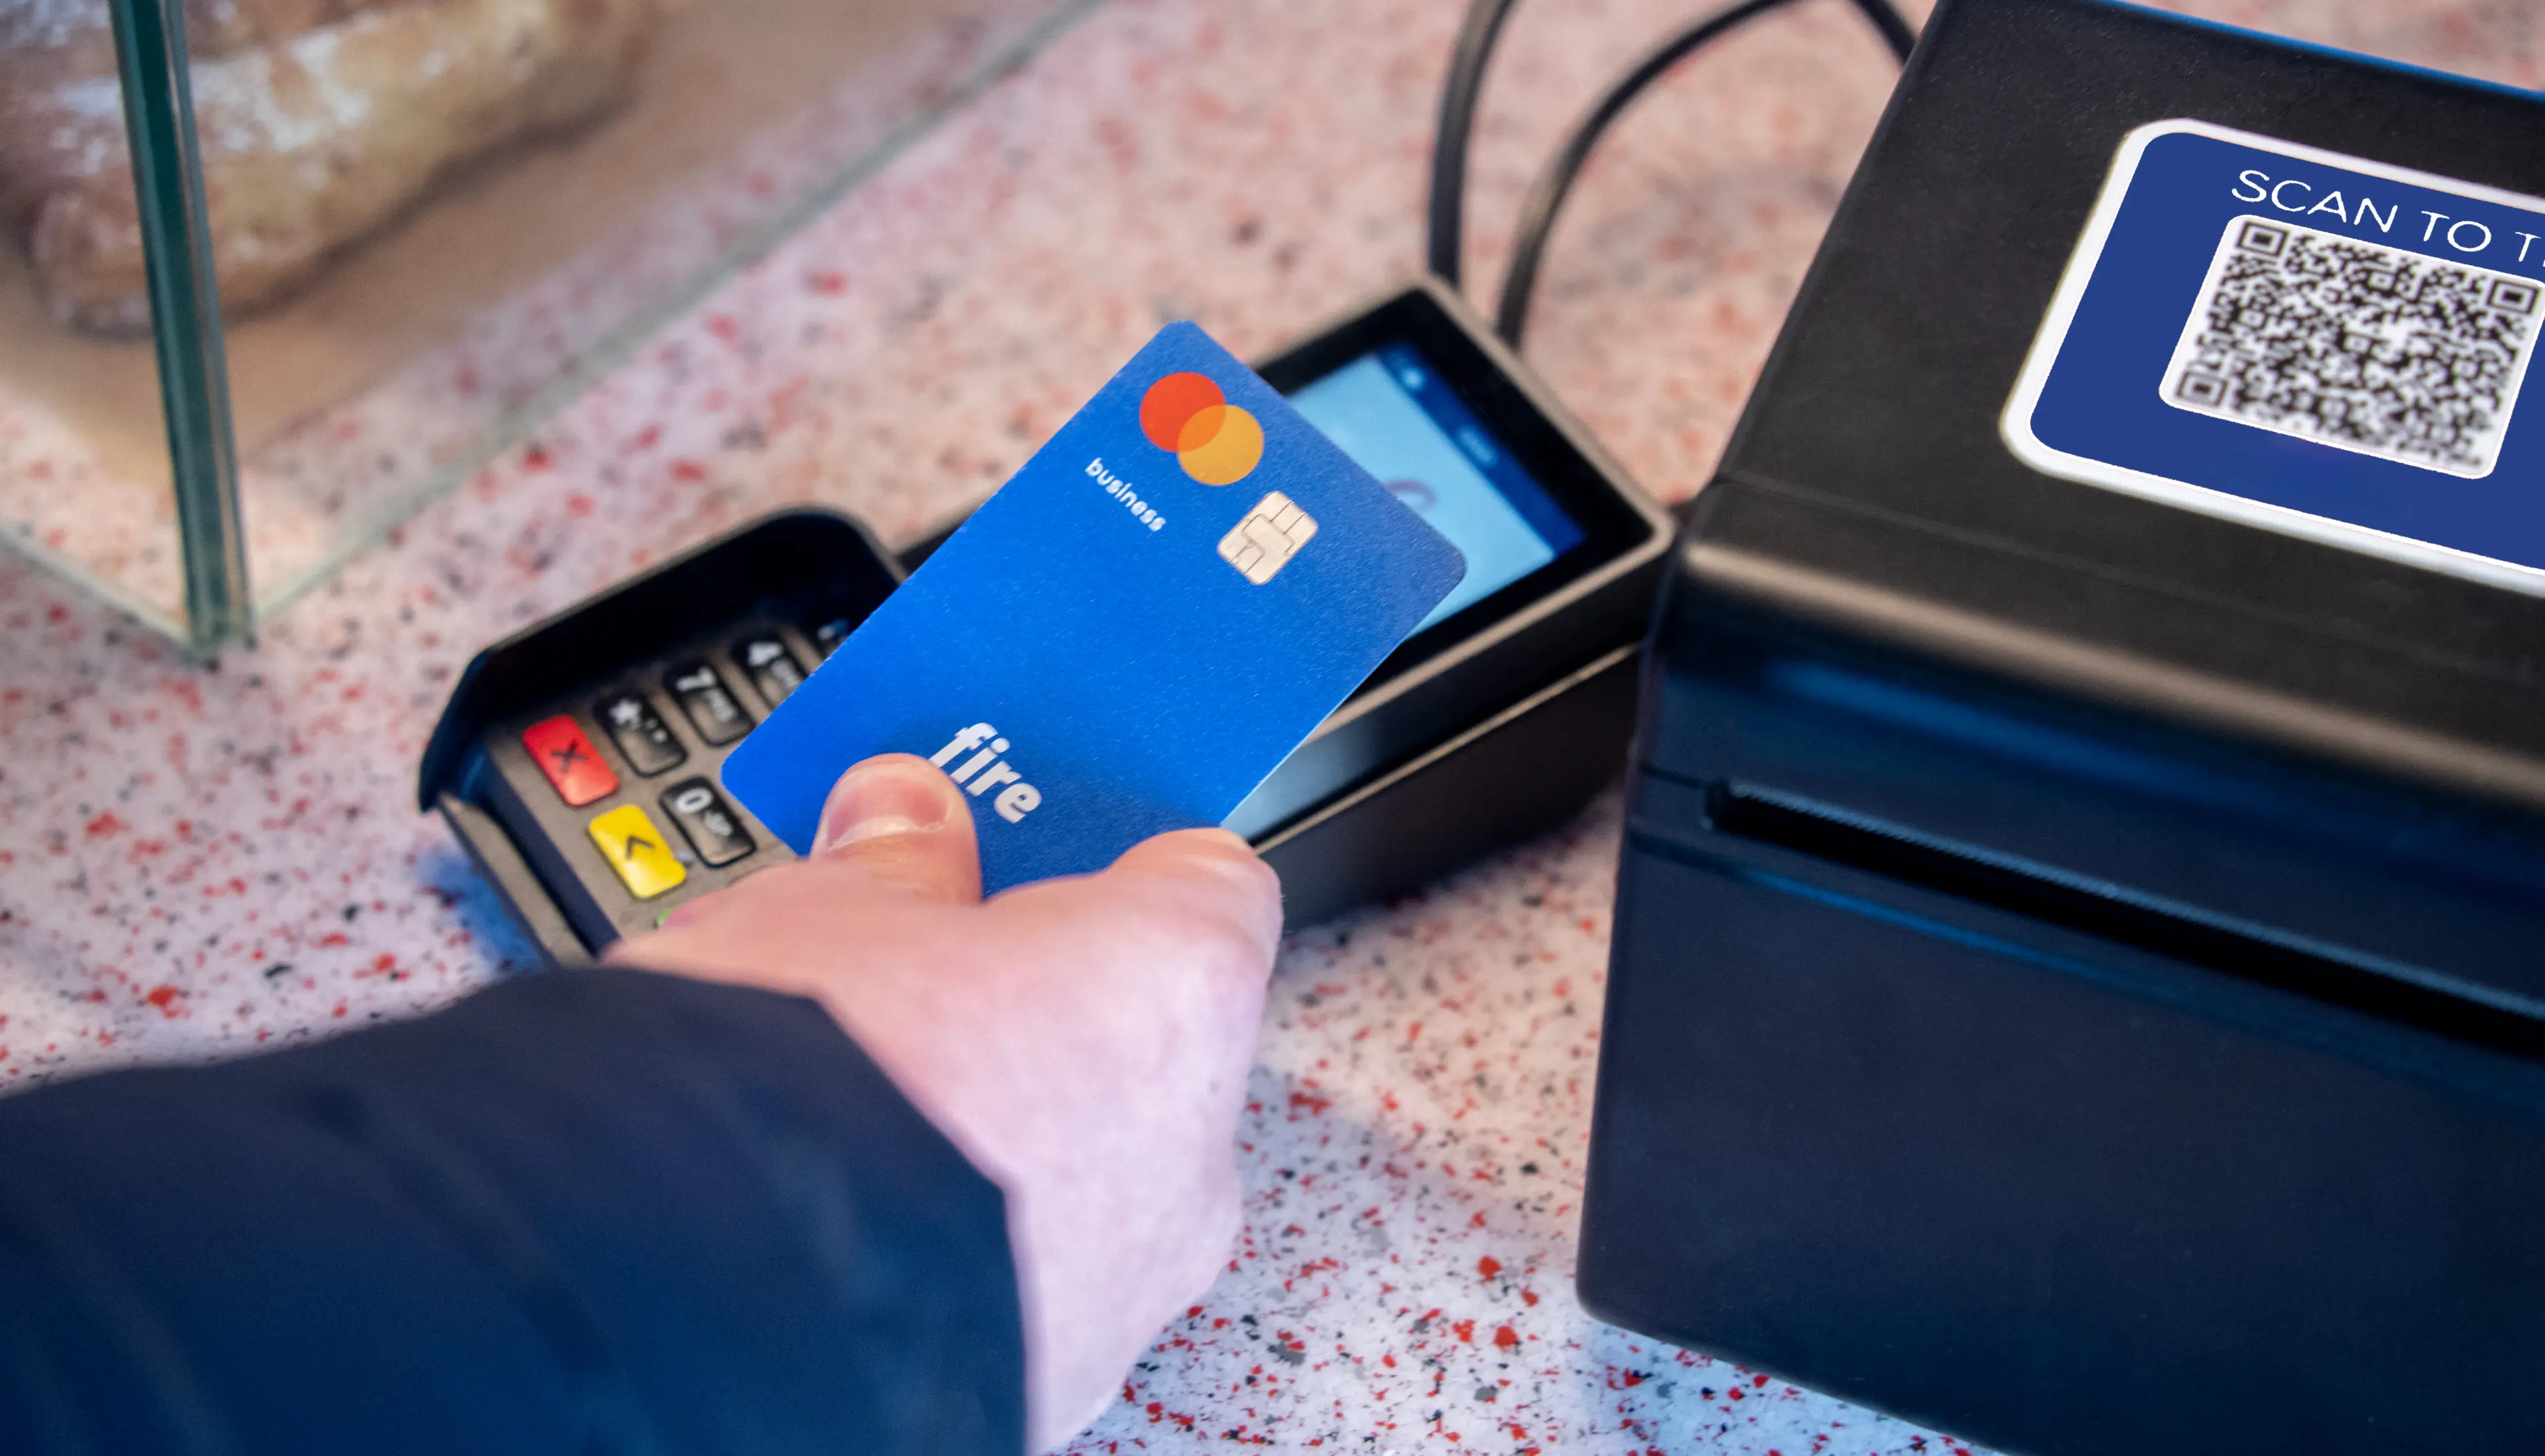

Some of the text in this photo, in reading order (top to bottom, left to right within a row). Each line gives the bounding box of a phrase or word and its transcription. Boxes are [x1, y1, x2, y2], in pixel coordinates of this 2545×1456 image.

[2232, 170, 2545, 267] SCAN TO T
[1084, 457, 1166, 532] business
[929, 722, 1042, 824] fire
